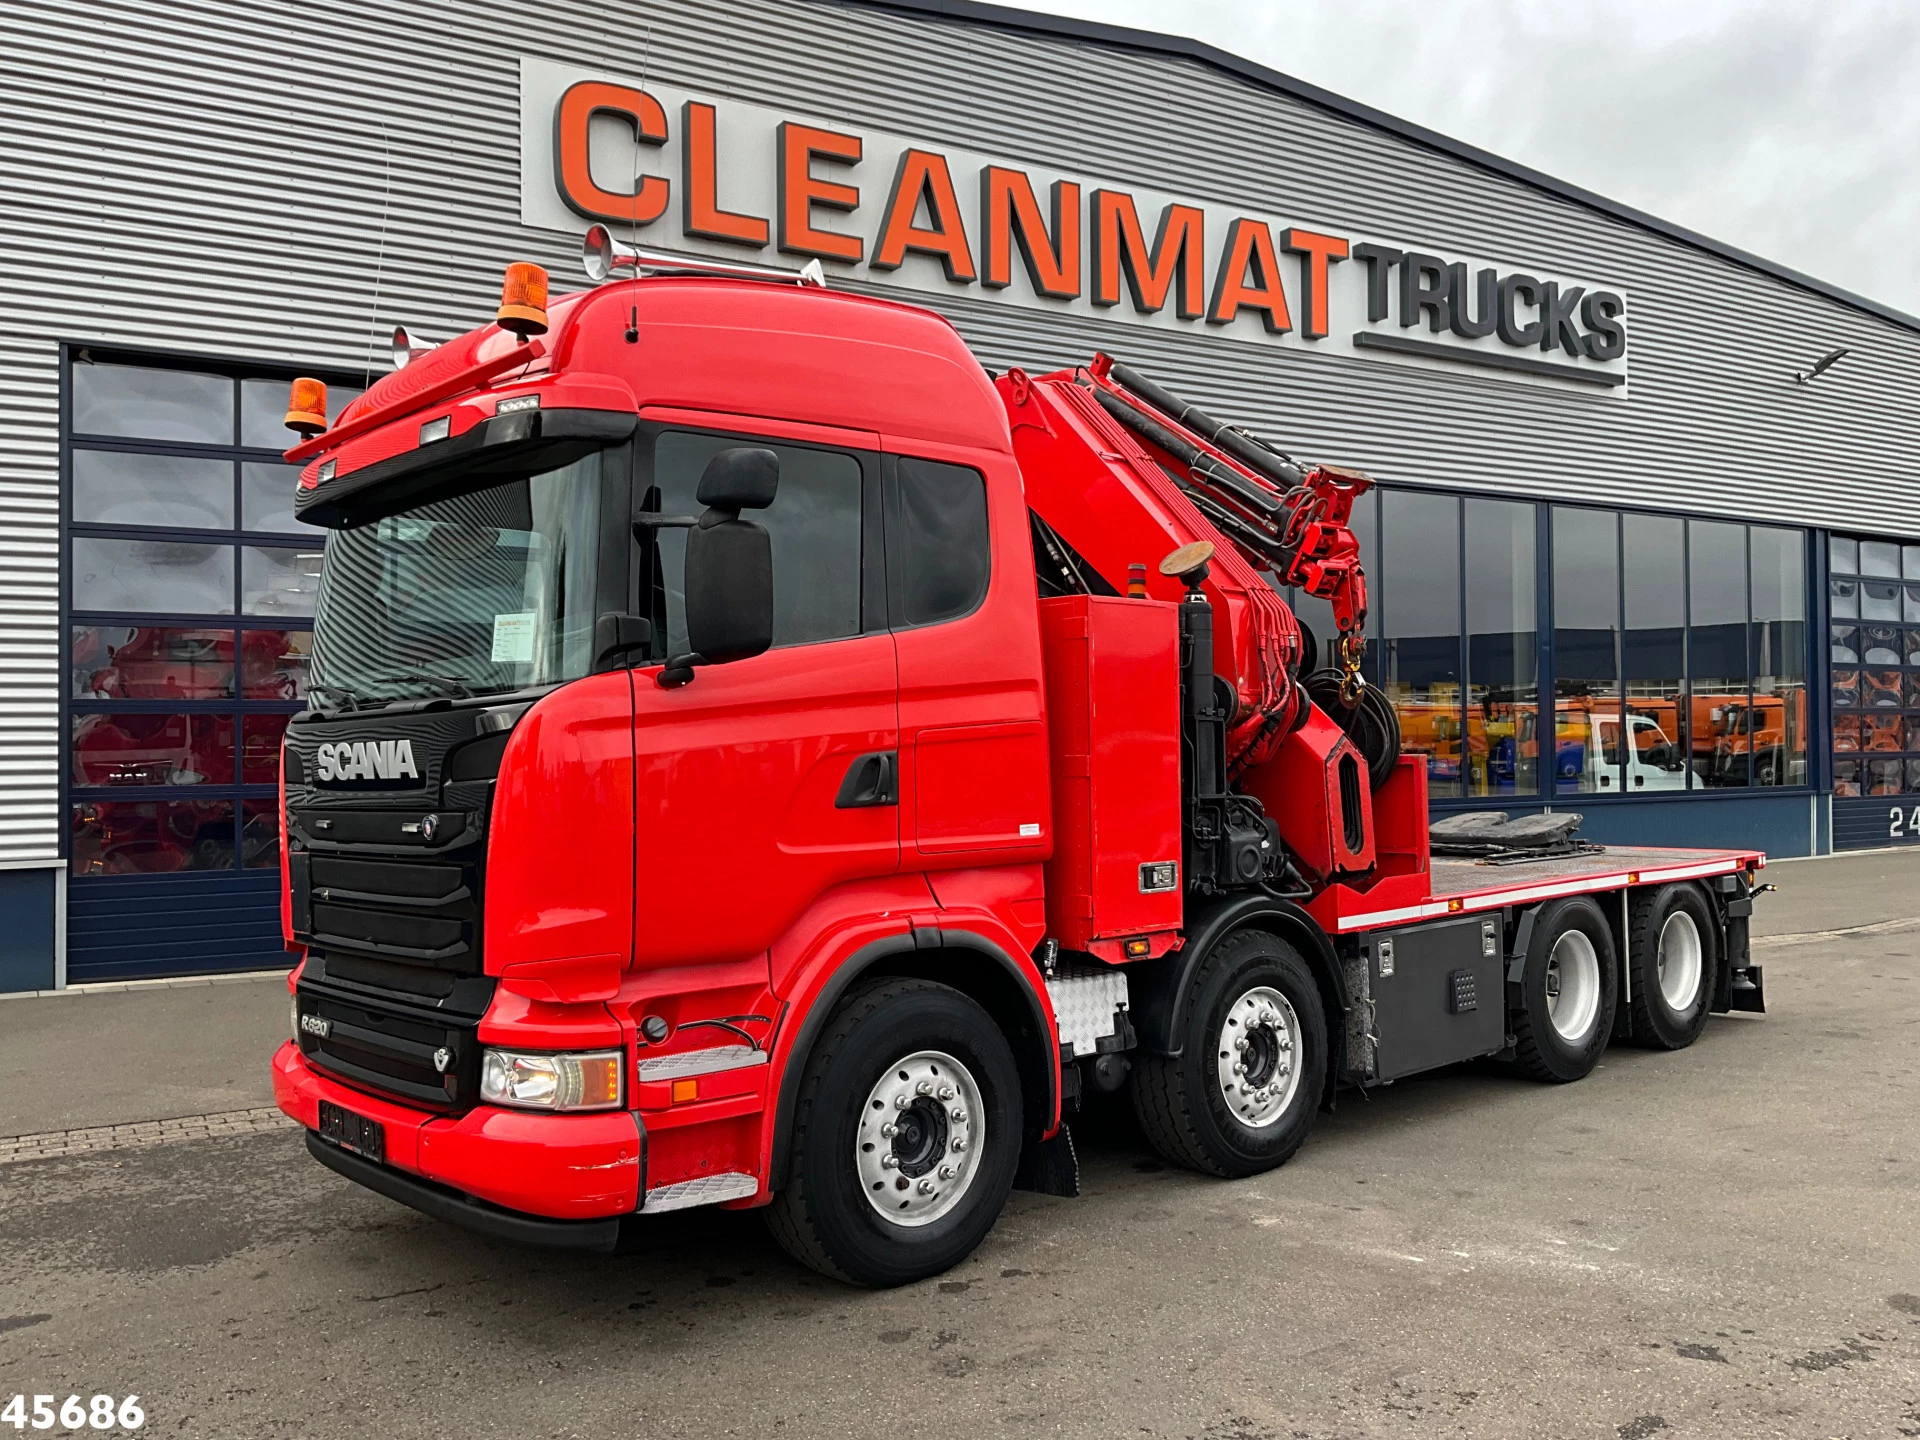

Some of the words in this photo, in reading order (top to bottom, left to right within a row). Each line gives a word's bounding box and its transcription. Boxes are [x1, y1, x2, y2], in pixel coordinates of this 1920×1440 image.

[553, 80, 1350, 339] CLEANMAT
[1352, 242, 1627, 362] TRUCKS
[317, 739, 419, 781] SCANIA
[1889, 806, 1920, 837] 24
